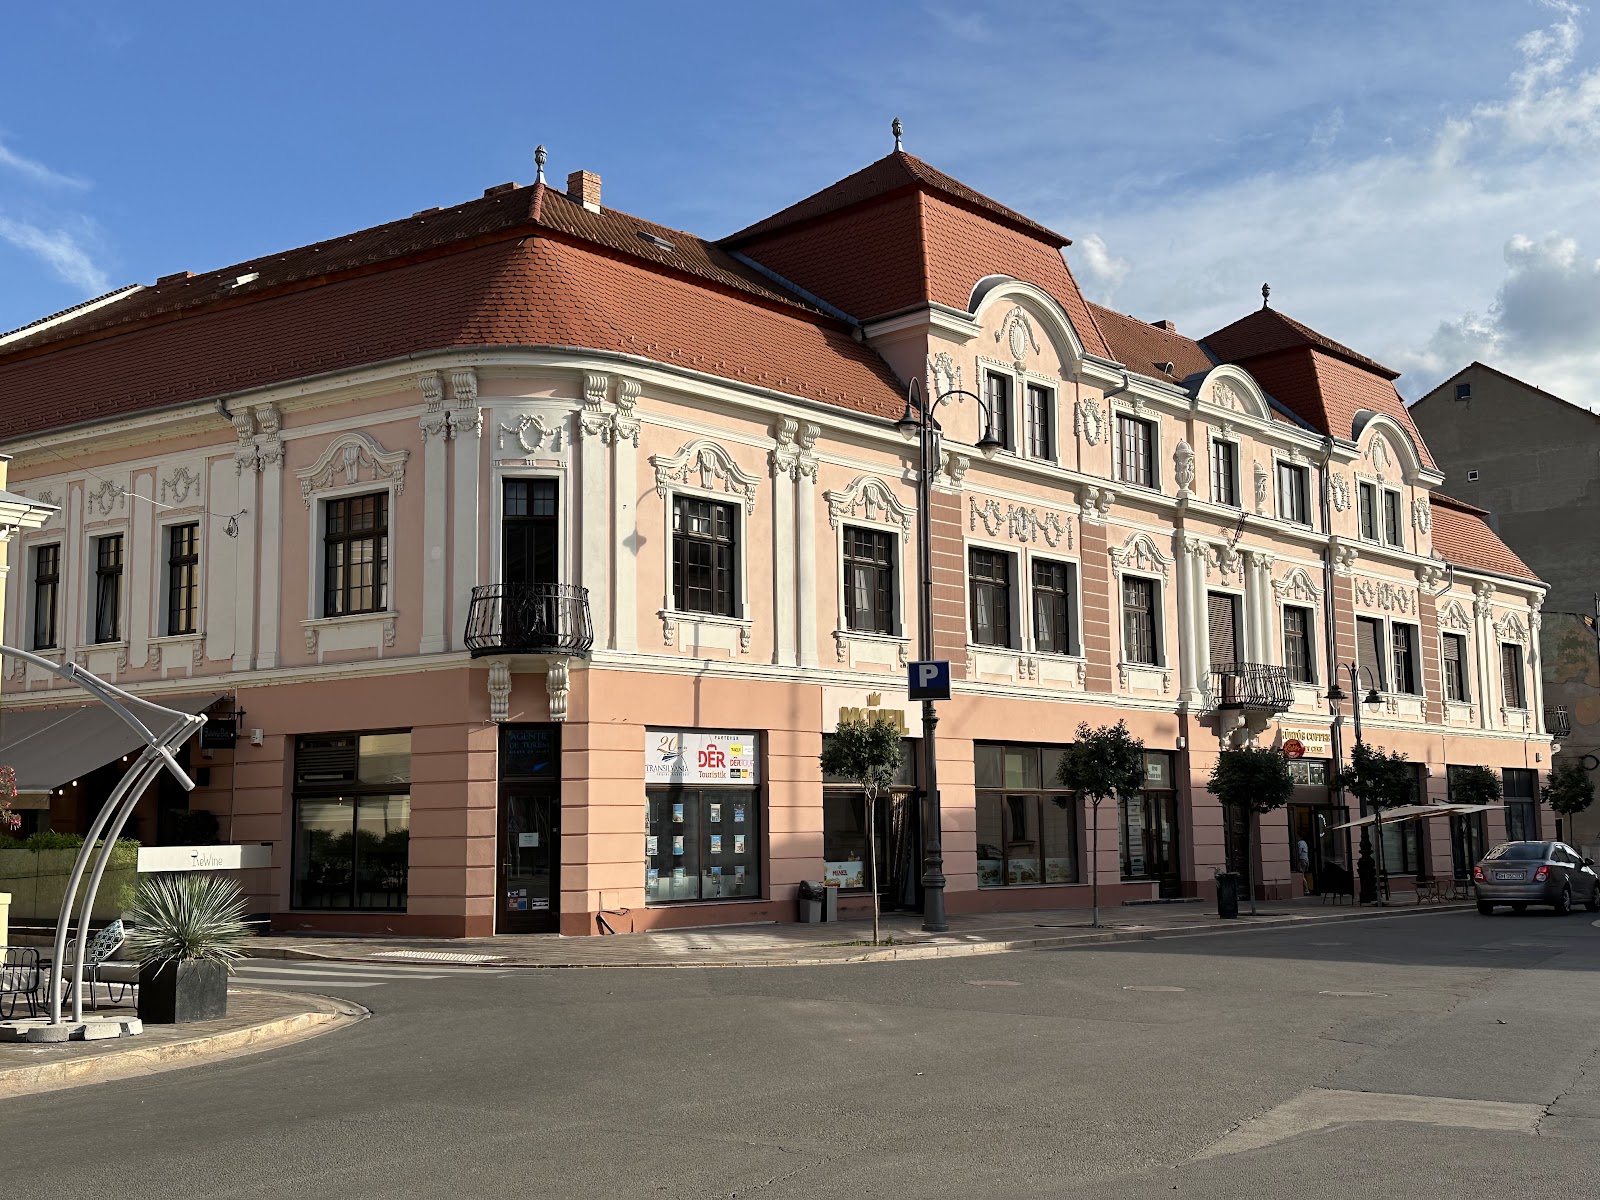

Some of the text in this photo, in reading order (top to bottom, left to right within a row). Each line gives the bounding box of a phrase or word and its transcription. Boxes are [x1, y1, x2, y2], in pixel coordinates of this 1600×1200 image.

[919, 664, 939, 687] P
[656, 735, 679, 754] 20
[645, 764, 689, 773] TRANSILVANIA
[698, 749, 726, 769] DER
[698, 770, 727, 779] Touristik
